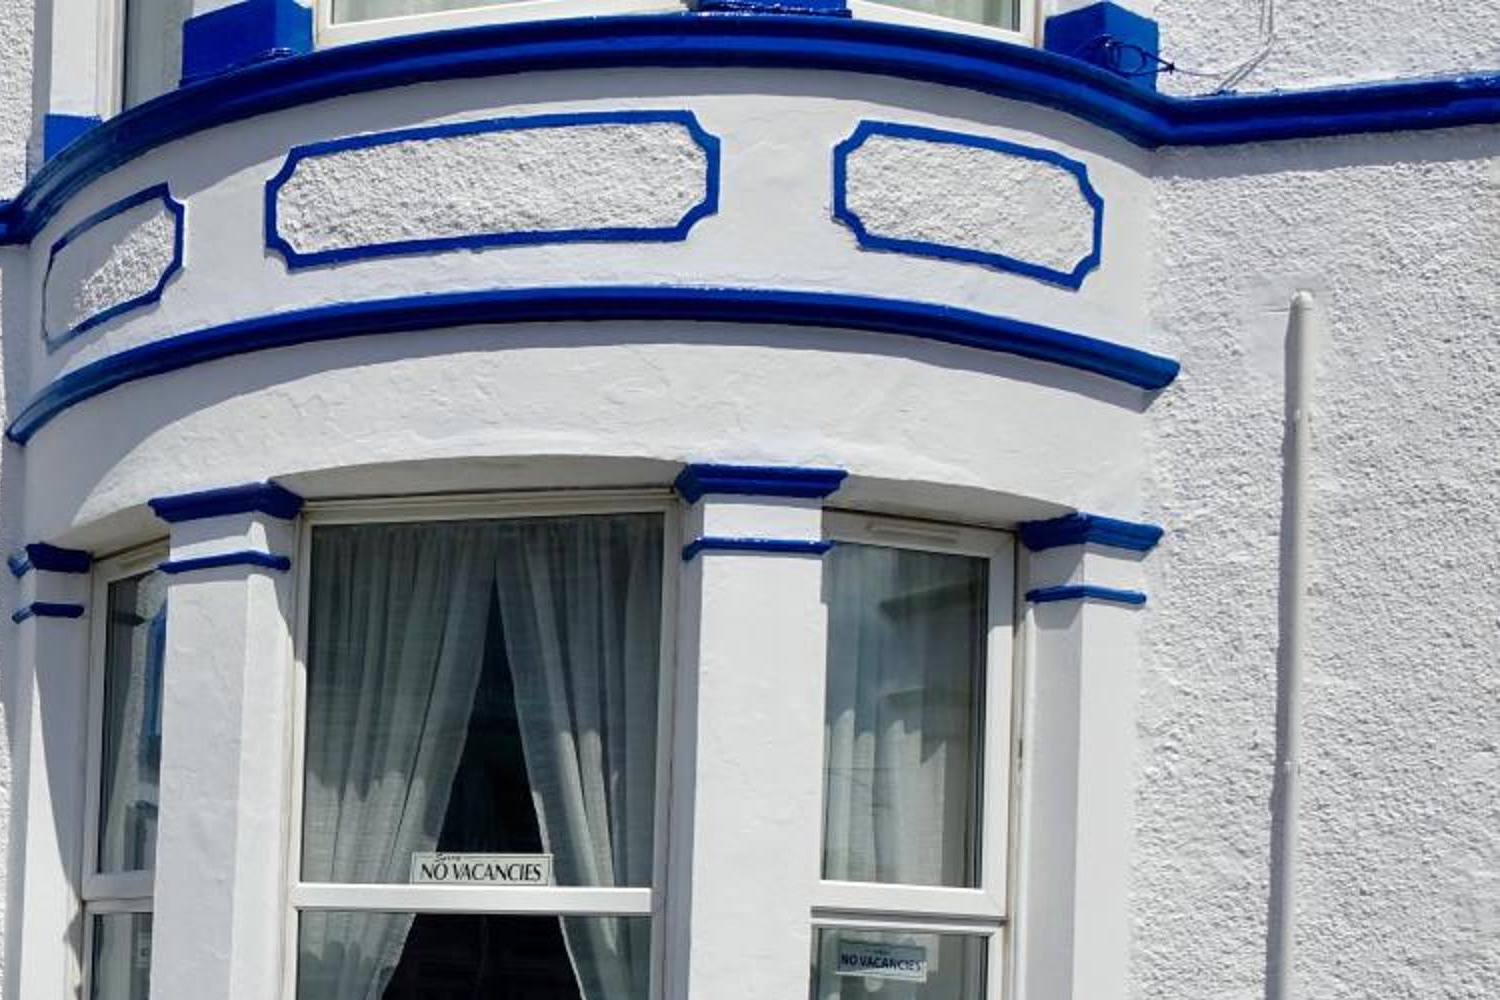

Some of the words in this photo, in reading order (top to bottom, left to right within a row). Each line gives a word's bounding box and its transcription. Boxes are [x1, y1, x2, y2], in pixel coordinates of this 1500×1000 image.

[420, 862, 449, 881] NO
[452, 863, 542, 882] VACANCIES
[840, 953, 859, 966] NO
[860, 956, 924, 972] VACANCIES
